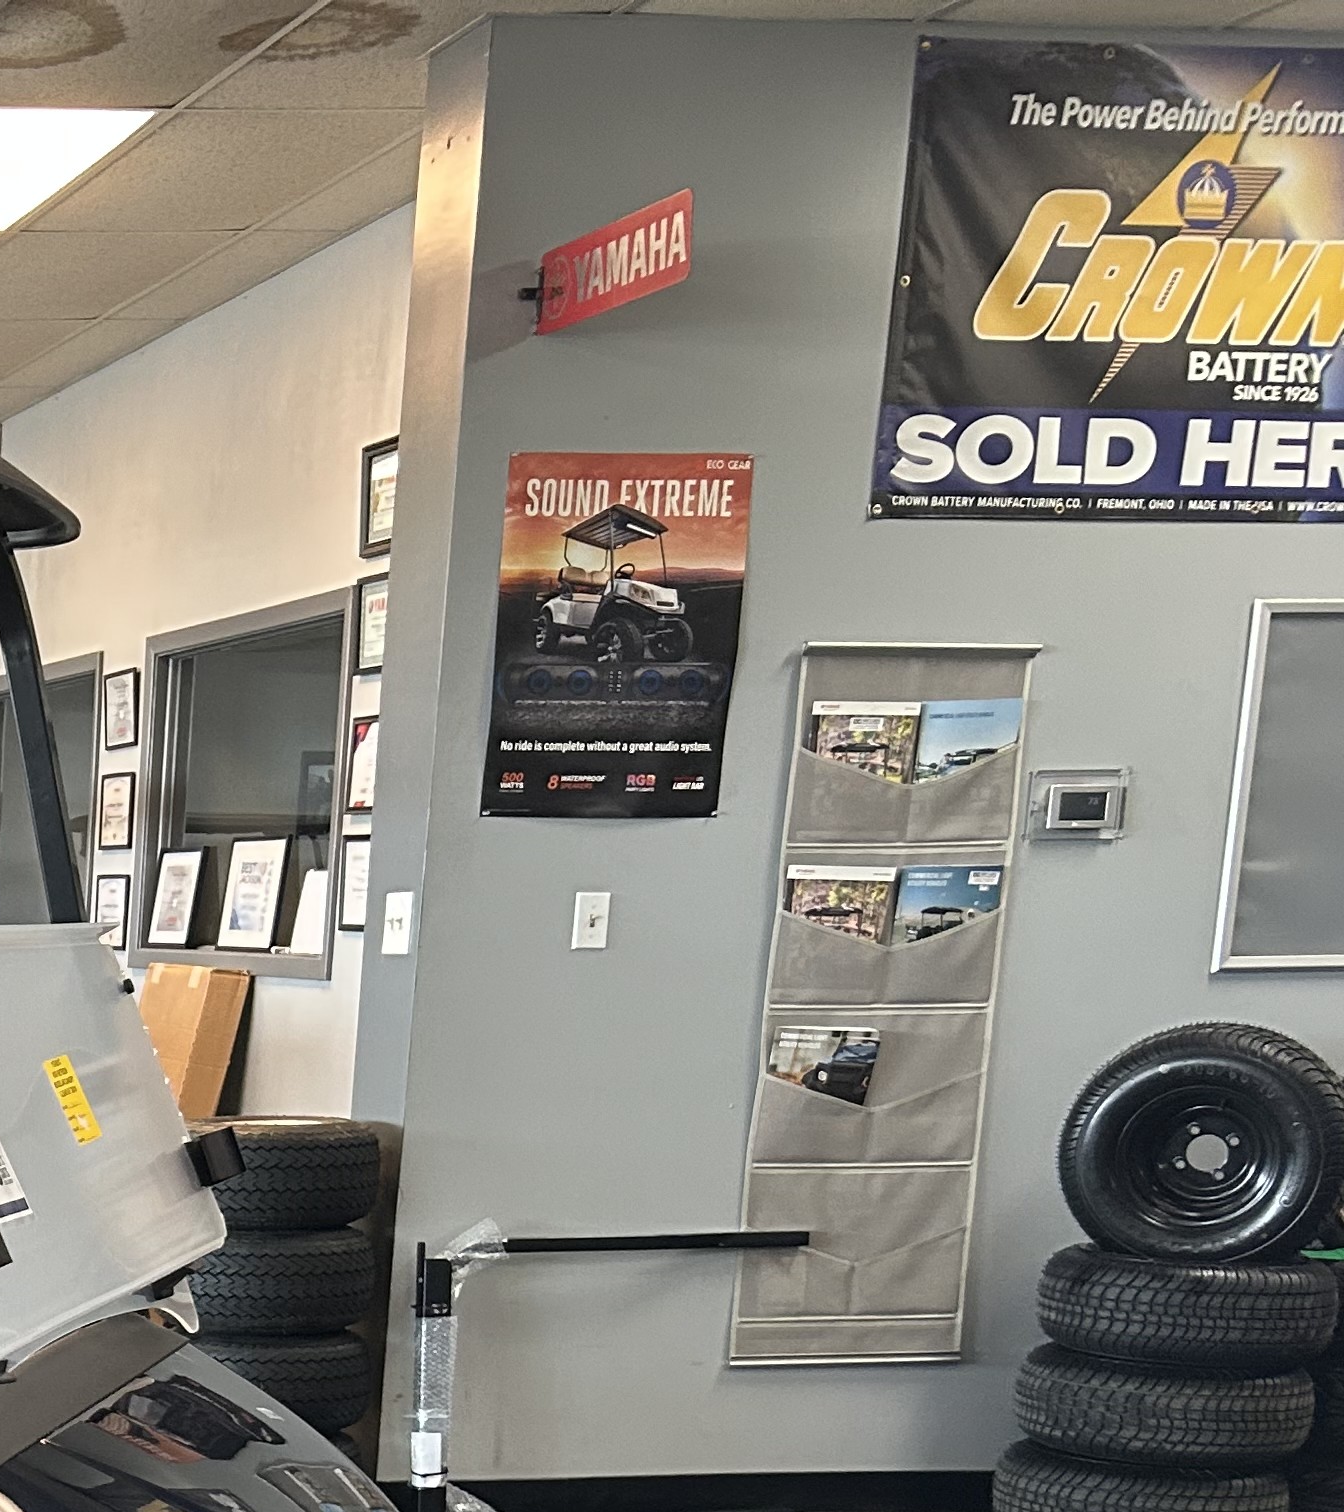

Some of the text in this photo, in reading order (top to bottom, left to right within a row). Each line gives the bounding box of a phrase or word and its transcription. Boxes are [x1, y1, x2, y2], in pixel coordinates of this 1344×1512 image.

[1010, 93, 1056, 126] The
[1062, 97, 1144, 130] Power
[1144, 99, 1241, 133] Behind
[573, 210, 686, 303] YAMAHA
[1188, 351, 1332, 384] BATTERY
[1233, 384, 1319, 402] SINCE 1926
[890, 413, 1158, 485] SOLD
[524, 478, 735, 517] SOUND EXTREME
[891, 495, 929, 506] CROWN
[930, 496, 975, 507] BATTERY
[976, 497, 1064, 509] MANUFACTURING
[1148, 499, 1176, 510] OHIO
[1187, 499, 1216, 510] MADE
[1218, 500, 1231, 511] IN
[500, 740, 513, 751] No
[514, 740, 533, 751] ride
[534, 740, 543, 751] is
[543, 740, 585, 753] complete
[586, 740, 621, 751] without
[622, 743, 628, 751] a
[629, 741, 653, 753] great
[654, 741, 679, 751] audio
[502, 772, 524, 782] 500
[547, 774, 560, 790] 8
[626, 774, 656, 786] RGB
